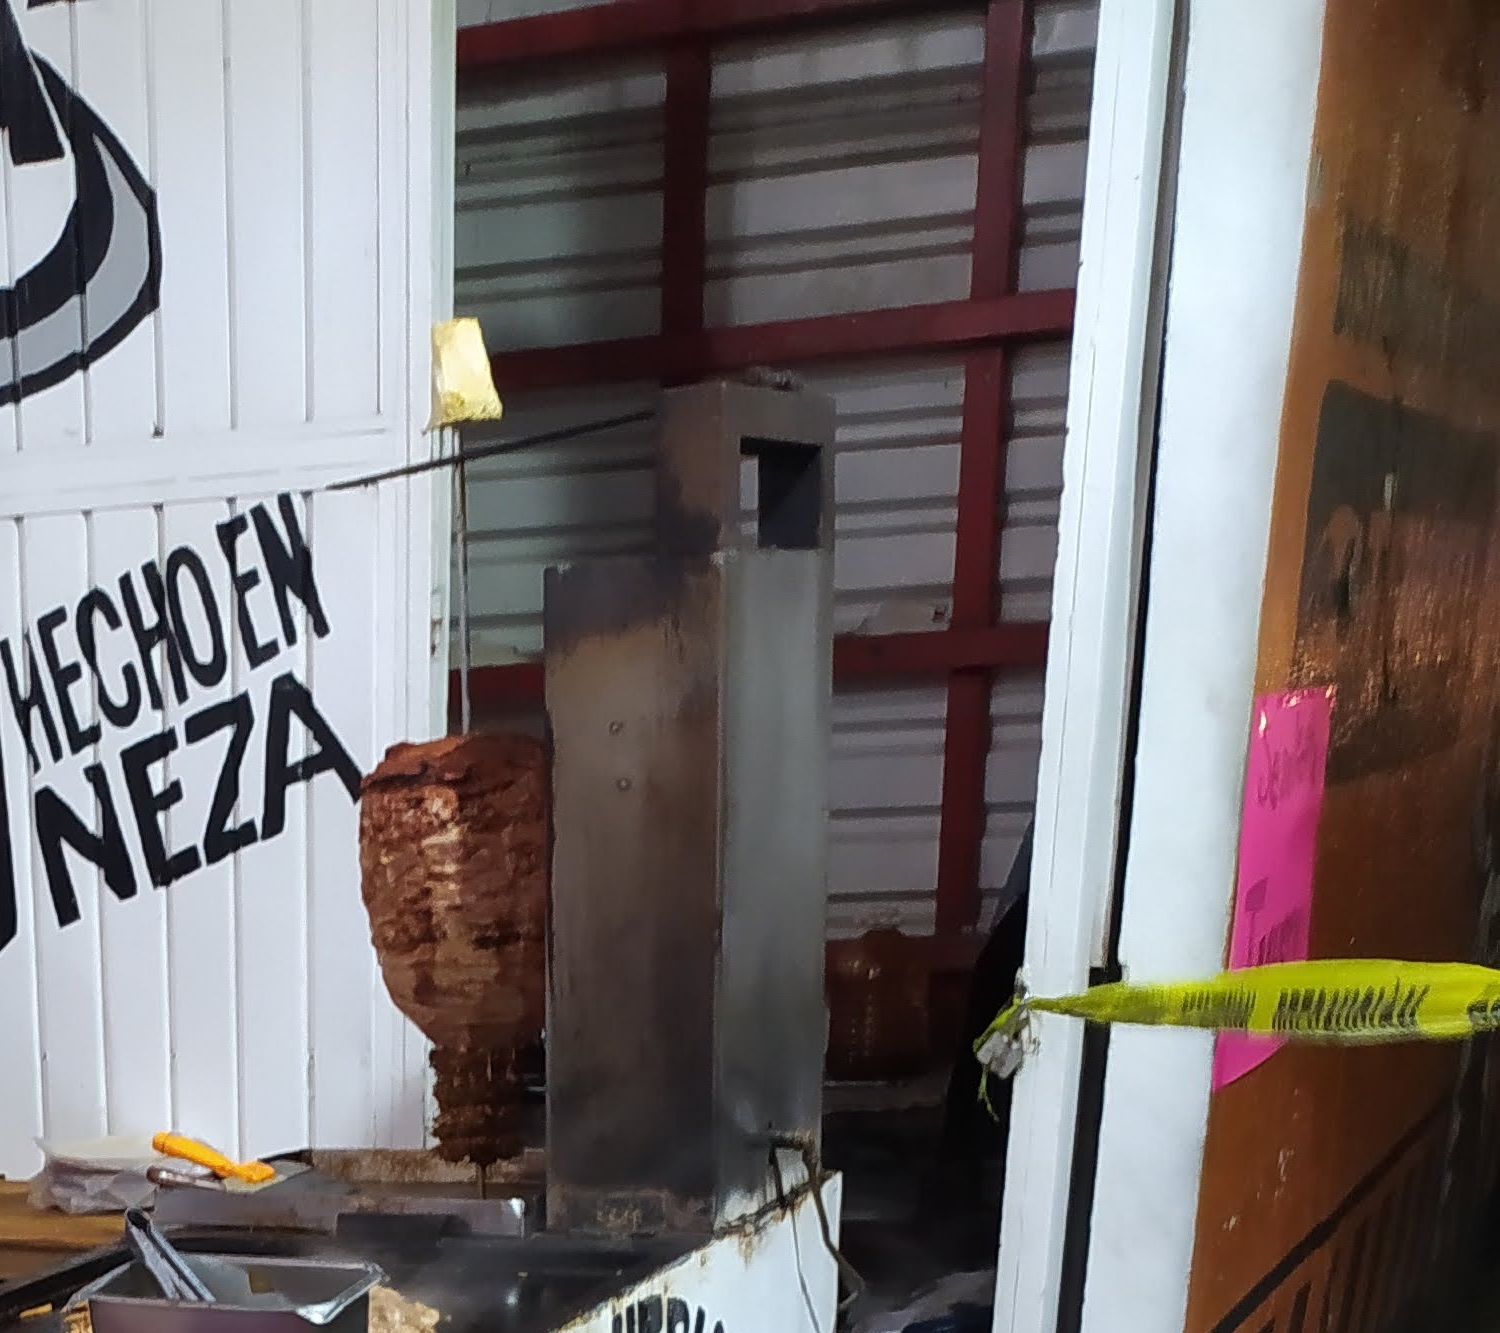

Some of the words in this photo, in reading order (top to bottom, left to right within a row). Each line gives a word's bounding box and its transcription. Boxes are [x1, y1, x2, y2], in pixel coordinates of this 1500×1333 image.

[0, 545, 228, 770] HECHO
[216, 493, 331, 670] EN
[35, 671, 362, 926] NEZA
